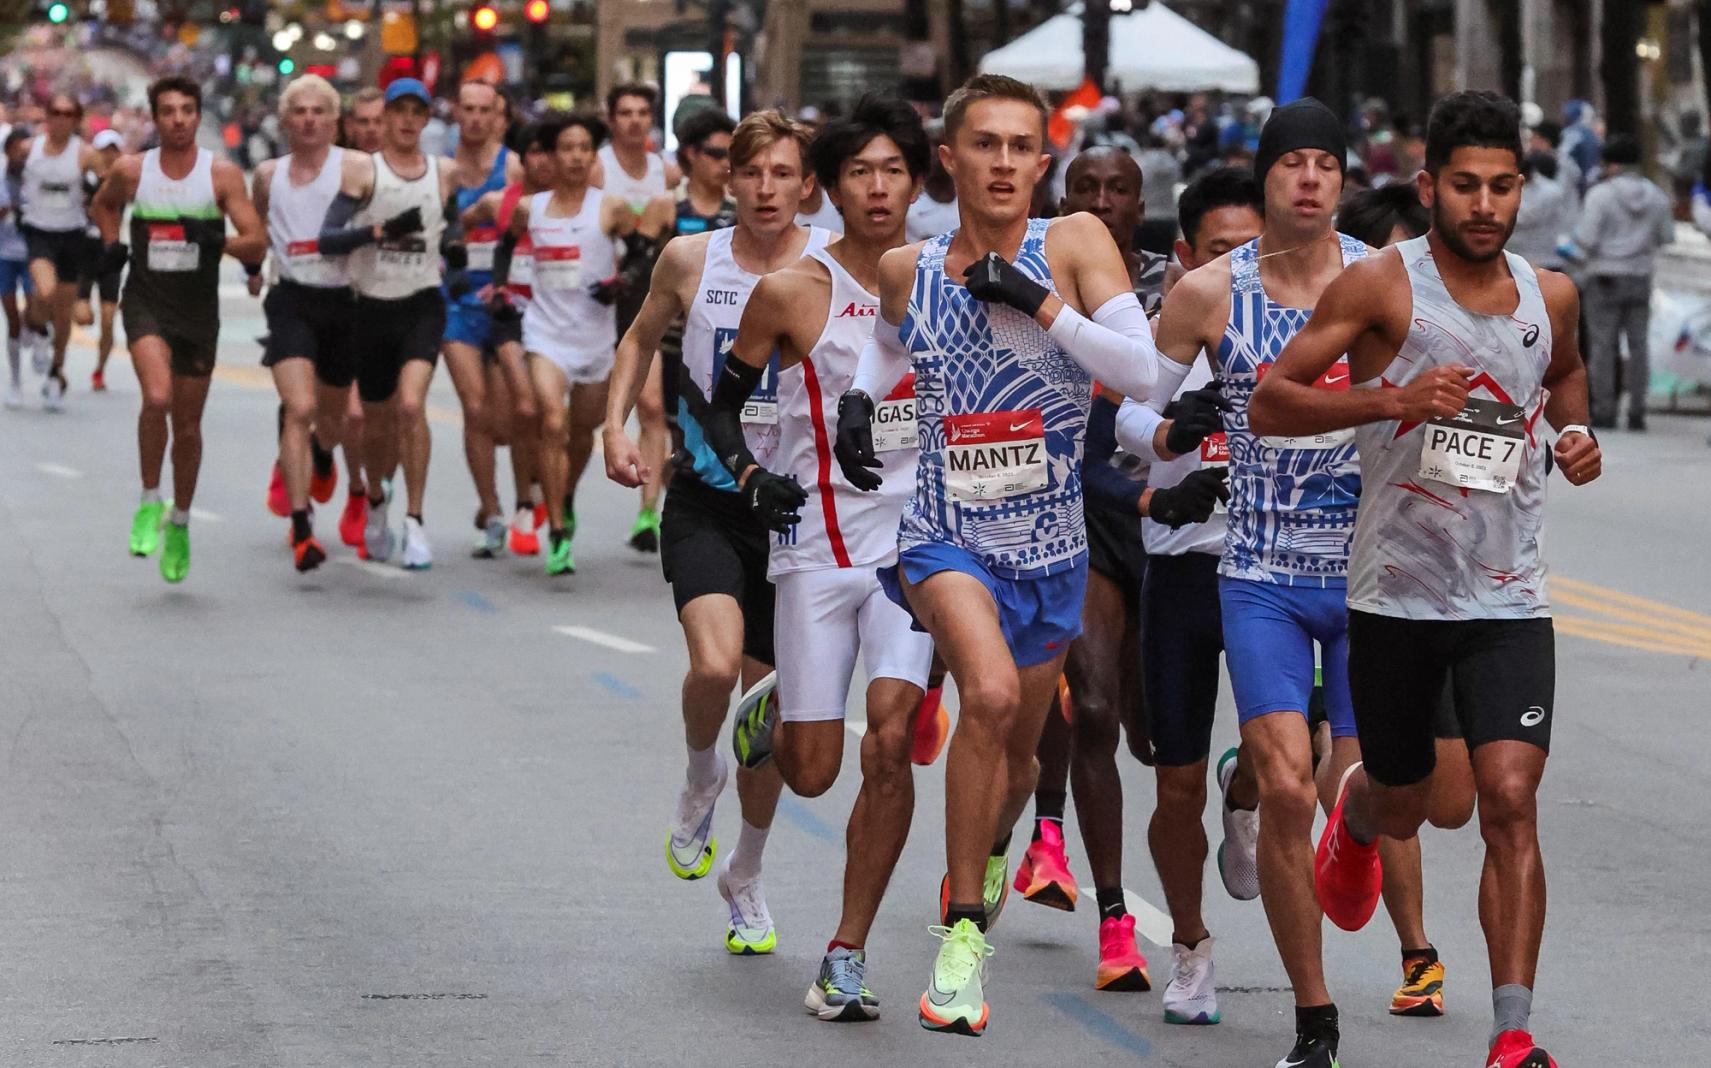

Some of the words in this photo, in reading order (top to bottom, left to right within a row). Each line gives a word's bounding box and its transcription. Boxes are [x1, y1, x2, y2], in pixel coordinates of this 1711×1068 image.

[706, 290, 738, 305] SCTC
[949, 443, 1041, 471] MANTZ
[1431, 430, 1493, 460] PACE
[1502, 442, 1515, 462] 7
